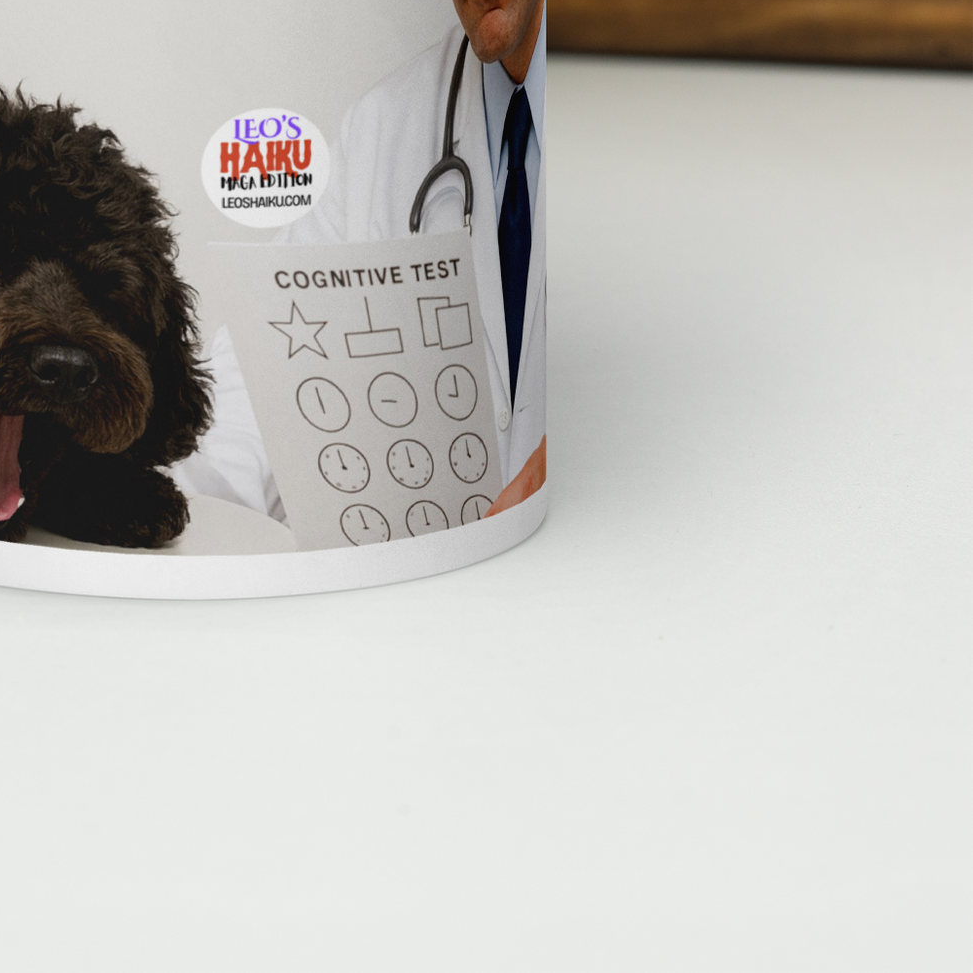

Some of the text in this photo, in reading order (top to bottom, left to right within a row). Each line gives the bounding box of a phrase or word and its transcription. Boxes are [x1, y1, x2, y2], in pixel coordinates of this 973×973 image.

[233, 114, 302, 145] LEO'S
[220, 139, 312, 181] HAIKU
[220, 172, 313, 191] MAGA EDITION
[221, 194, 312, 209] LEOSHAIKU.COM
[274, 258, 461, 289] COGNITIVE TEST
